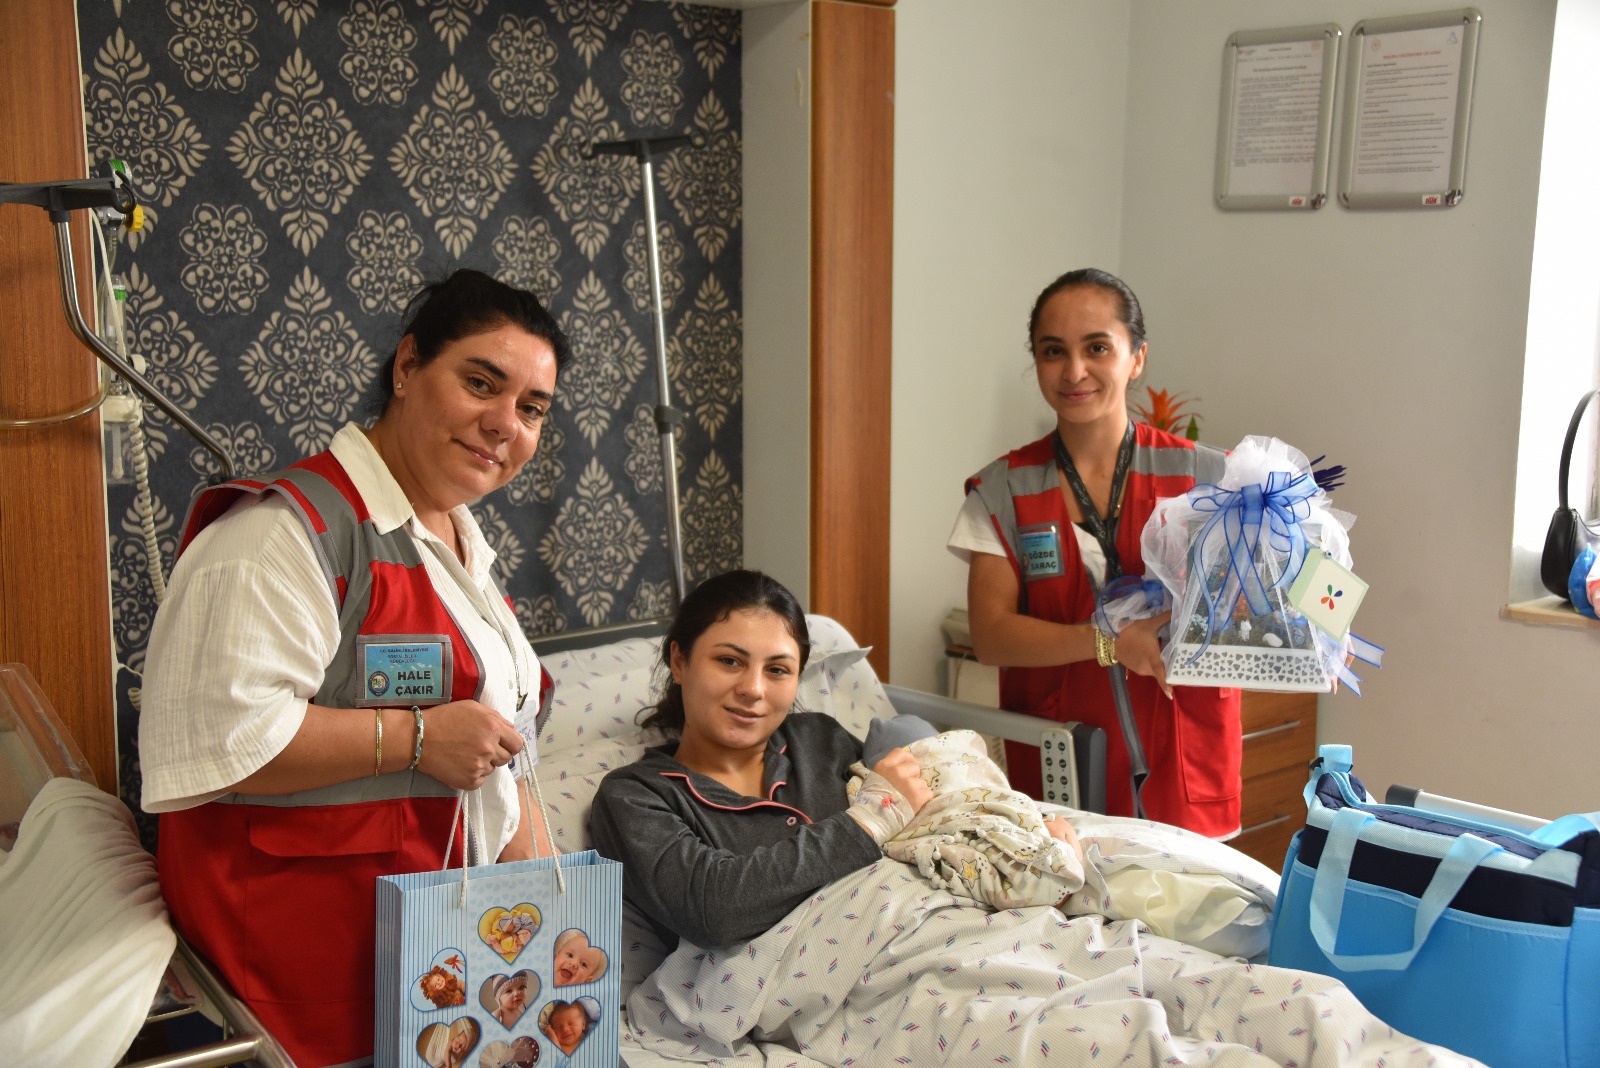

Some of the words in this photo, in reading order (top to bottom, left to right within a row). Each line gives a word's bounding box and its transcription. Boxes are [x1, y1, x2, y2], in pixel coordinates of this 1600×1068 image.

[1028, 551, 1055, 560] GÖZDE
[1031, 561, 1056, 570] SARAÇ
[398, 671, 431, 680] HALE
[395, 685, 433, 696] ÇAKIR
